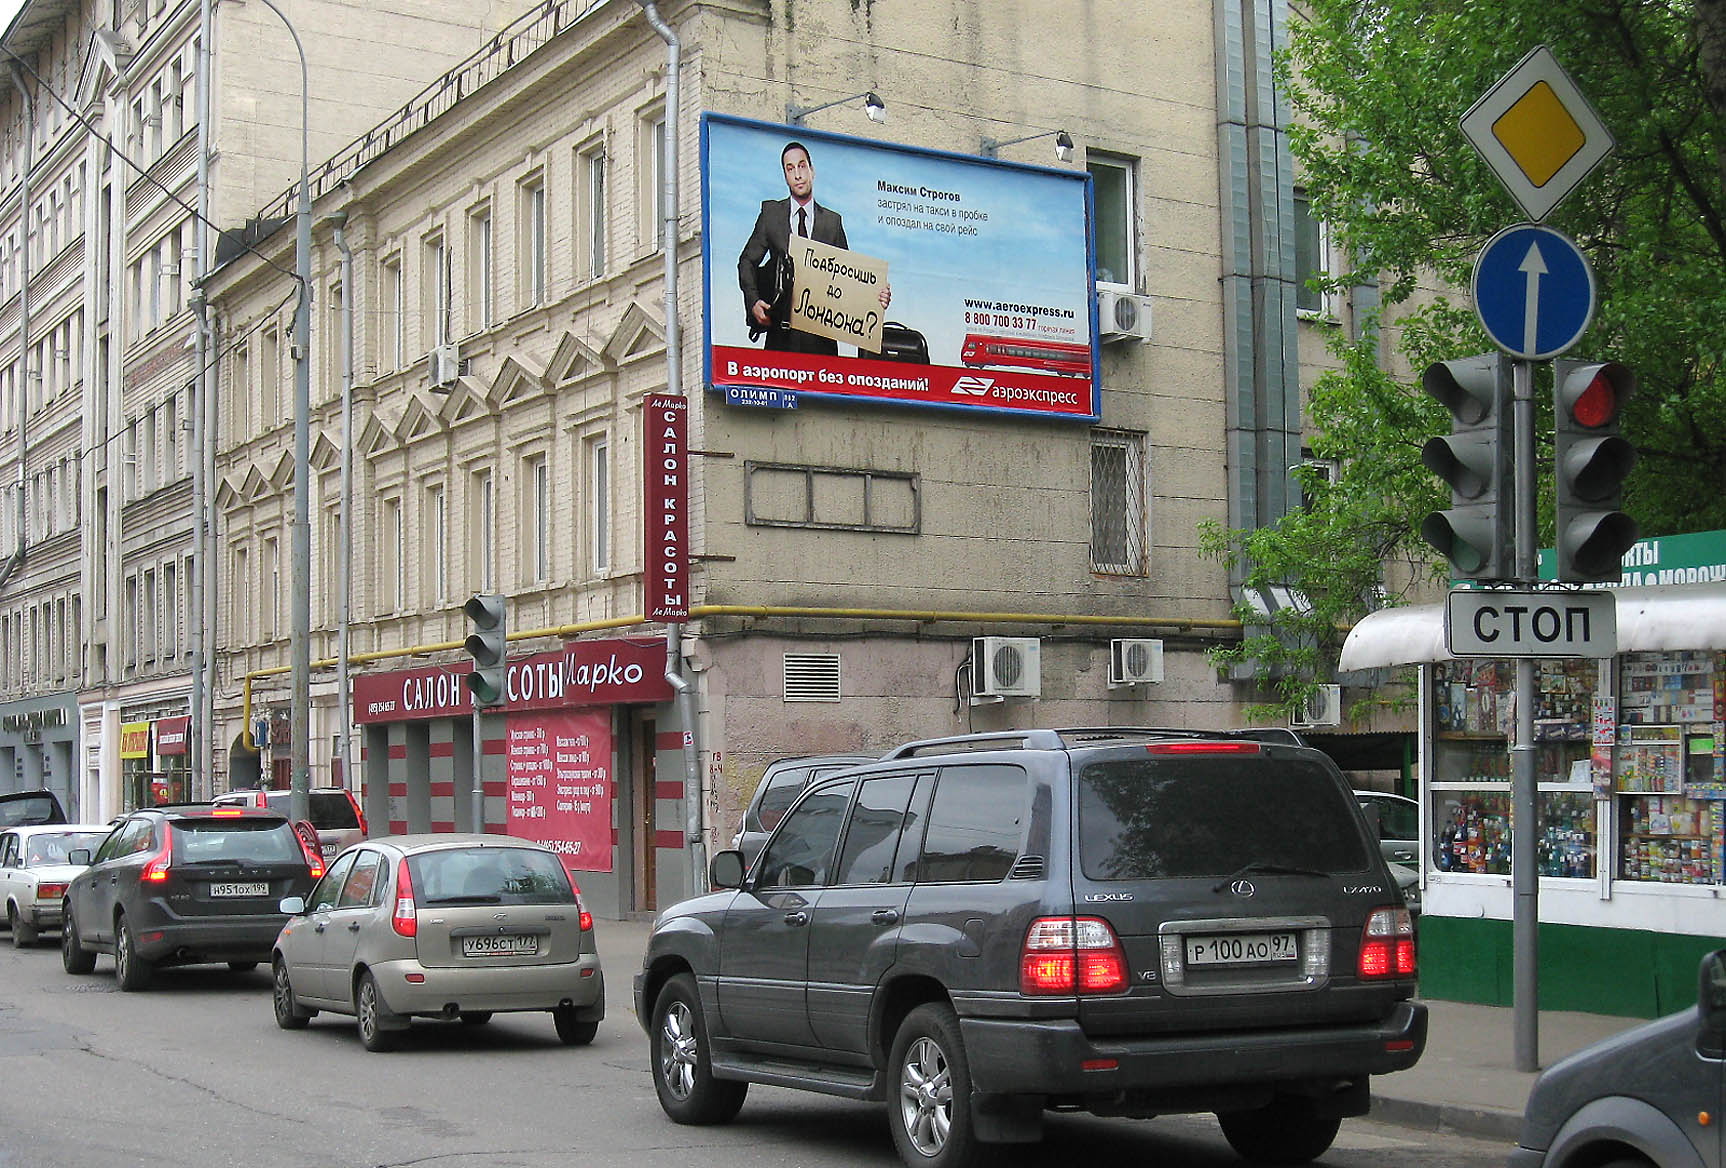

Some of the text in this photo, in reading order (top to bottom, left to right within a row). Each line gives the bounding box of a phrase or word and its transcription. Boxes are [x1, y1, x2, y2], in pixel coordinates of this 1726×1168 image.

[877, 180, 961, 202] Максим Строгов
[877, 199, 988, 222] застрял на такси в пробке
[878, 215, 978, 237] и опоздал на свой рейс
[804, 248, 877, 285] Подбросишь
[826, 285, 842, 299] до
[793, 288, 878, 339] Лондона?
[964, 298, 1075, 319] www.aeroexpress.ru
[965, 312, 971, 323] 8
[973, 312, 990, 326] 800
[993, 314, 1010, 327] 700
[1012, 317, 1024, 329] 33
[1026, 318, 1037, 330] 77
[727, 361, 930, 392] В аэропорт без опозданий!
[730, 388, 777, 401] ОЛИМП
[992, 386, 1078, 406] аэроэкспресс
[663, 411, 678, 487] САЛОН
[663, 498, 682, 606] КРАСОТЫ
[1473, 605, 1591, 643] СТОП
[403, 674, 461, 711] САЛОН
[1084, 893, 1135, 902] LEXUS
